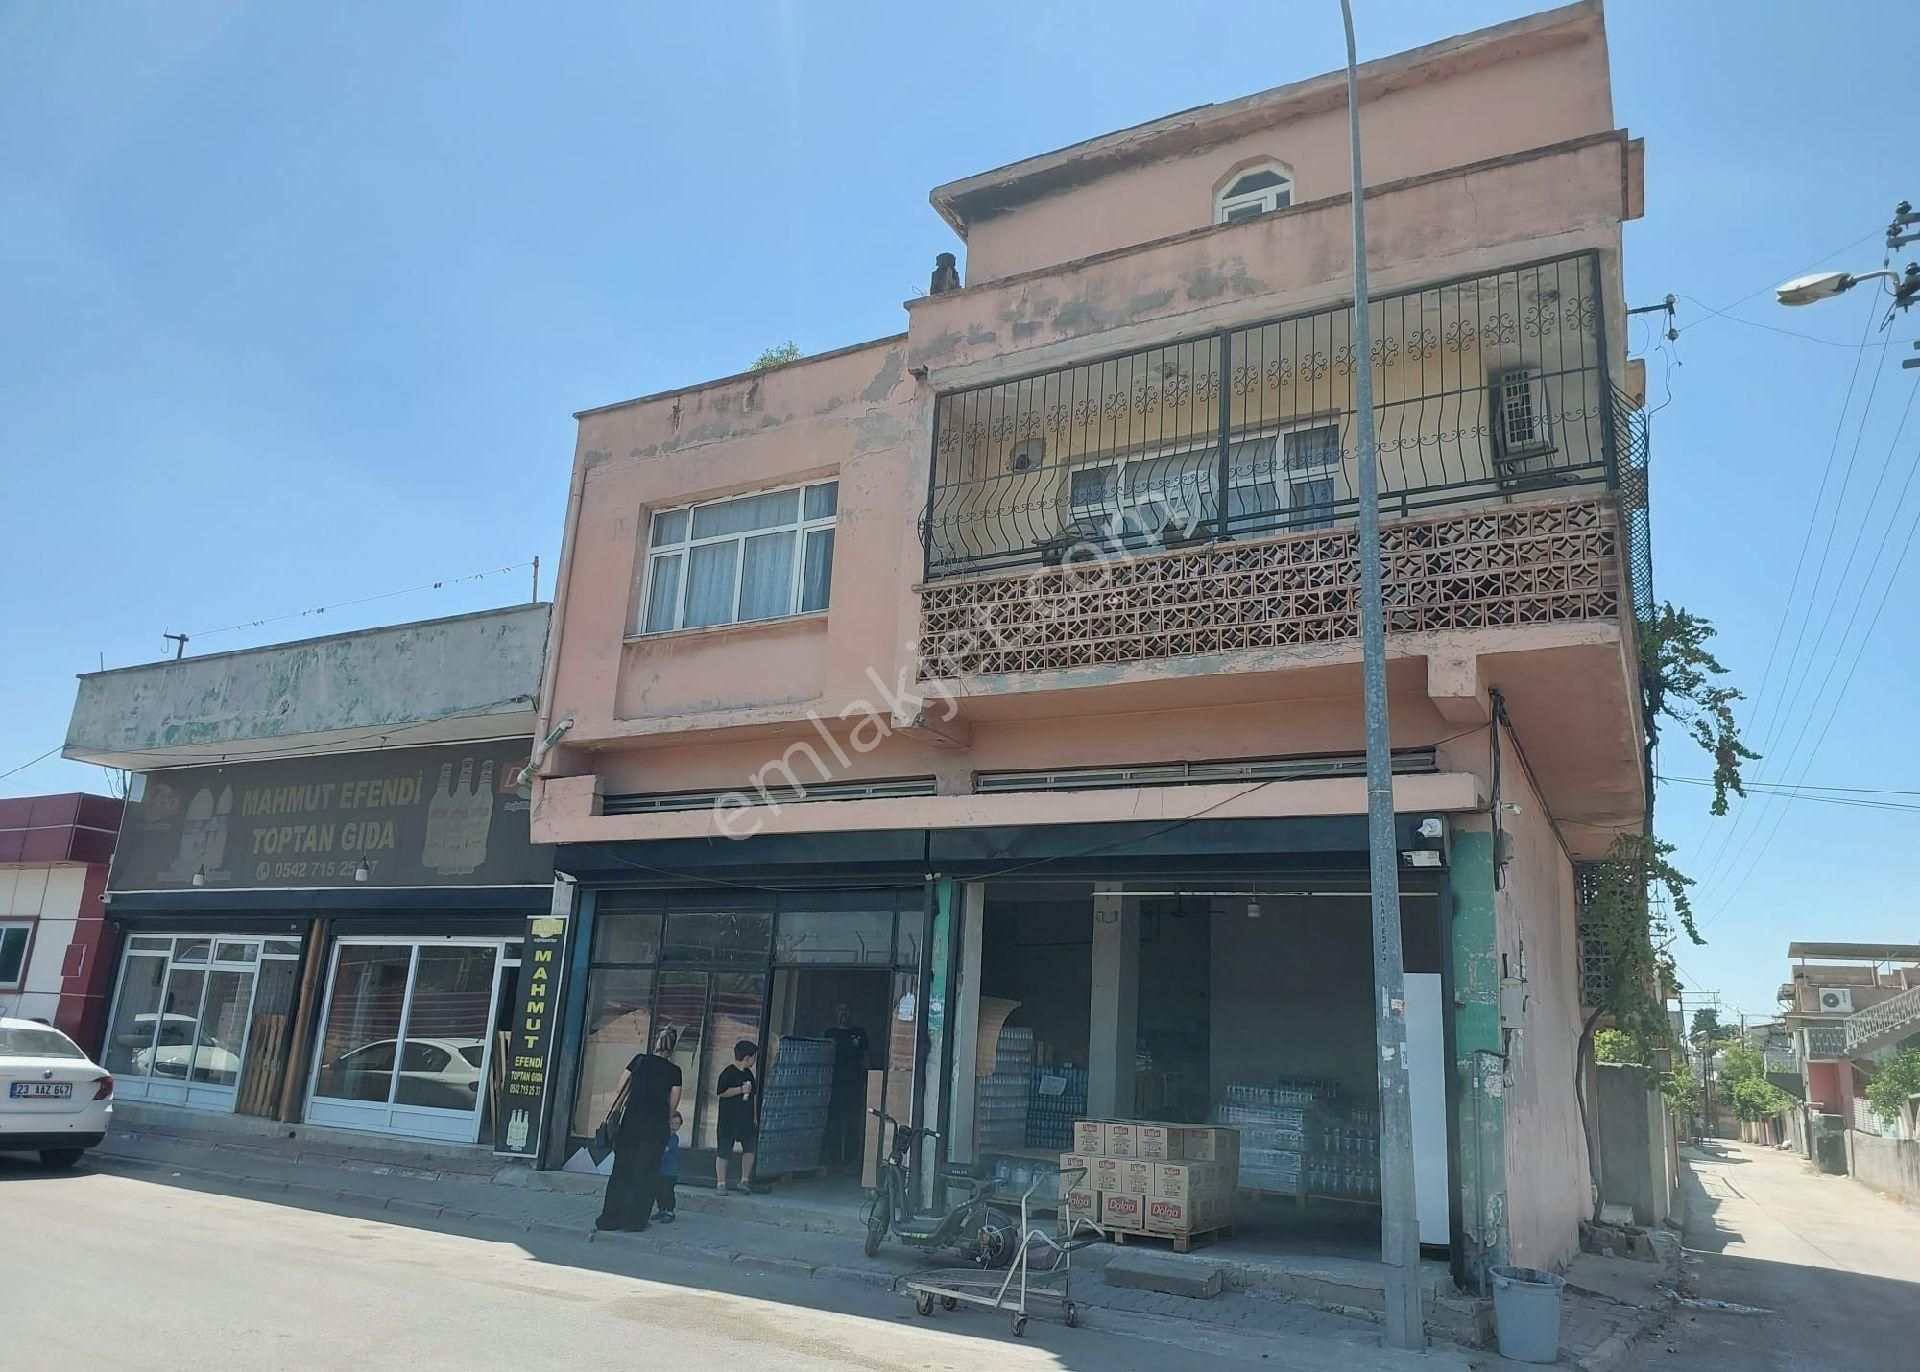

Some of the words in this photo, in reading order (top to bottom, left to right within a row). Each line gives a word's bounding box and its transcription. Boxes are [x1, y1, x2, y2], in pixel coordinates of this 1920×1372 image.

[242, 782, 335, 816] MAHMUT
[339, 769, 423, 809] EFENDİ
[252, 823, 335, 855] TOPTAN
[341, 820, 395, 851] GIDA
[274, 862, 307, 879] 0542
[311, 861, 336, 878] 715
[359, 860, 380, 877] 7
[524, 950, 552, 1049] MAHMUT
[515, 1055, 543, 1069] EFENDİ
[511, 1070, 530, 1082] TOPTAN
[17, 1085, 30, 1094] 23
[35, 1085, 51, 1095] AAZ
[54, 1085, 70, 1095] 647
[1070, 1195, 1089, 1208] alga
[1109, 1199, 1135, 1212] Dalga
[1152, 1204, 1179, 1217] Dalga
